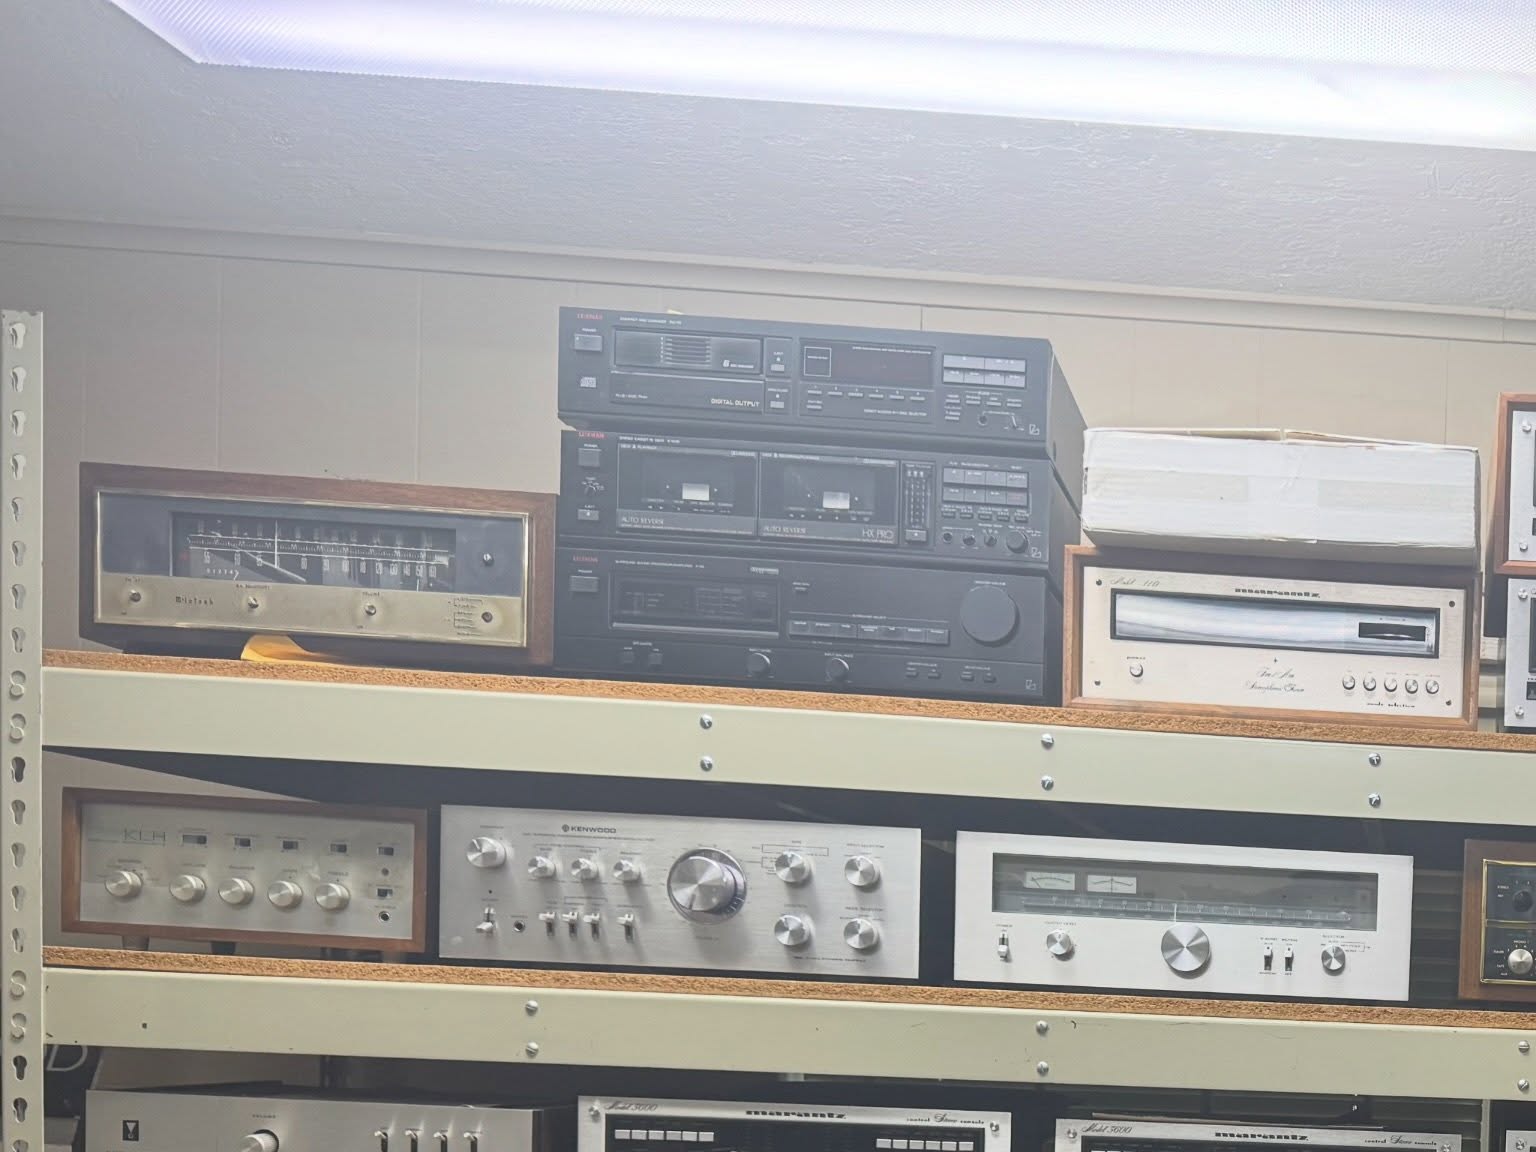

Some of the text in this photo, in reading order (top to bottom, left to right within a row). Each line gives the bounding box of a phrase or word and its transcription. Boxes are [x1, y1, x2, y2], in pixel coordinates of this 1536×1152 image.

[711, 398, 760, 408] DIGITAL OUTPUT
[862, 528, 895, 540] HX PRO
[124, 828, 167, 842] KLH
[570, 826, 617, 835] KENWOOD
